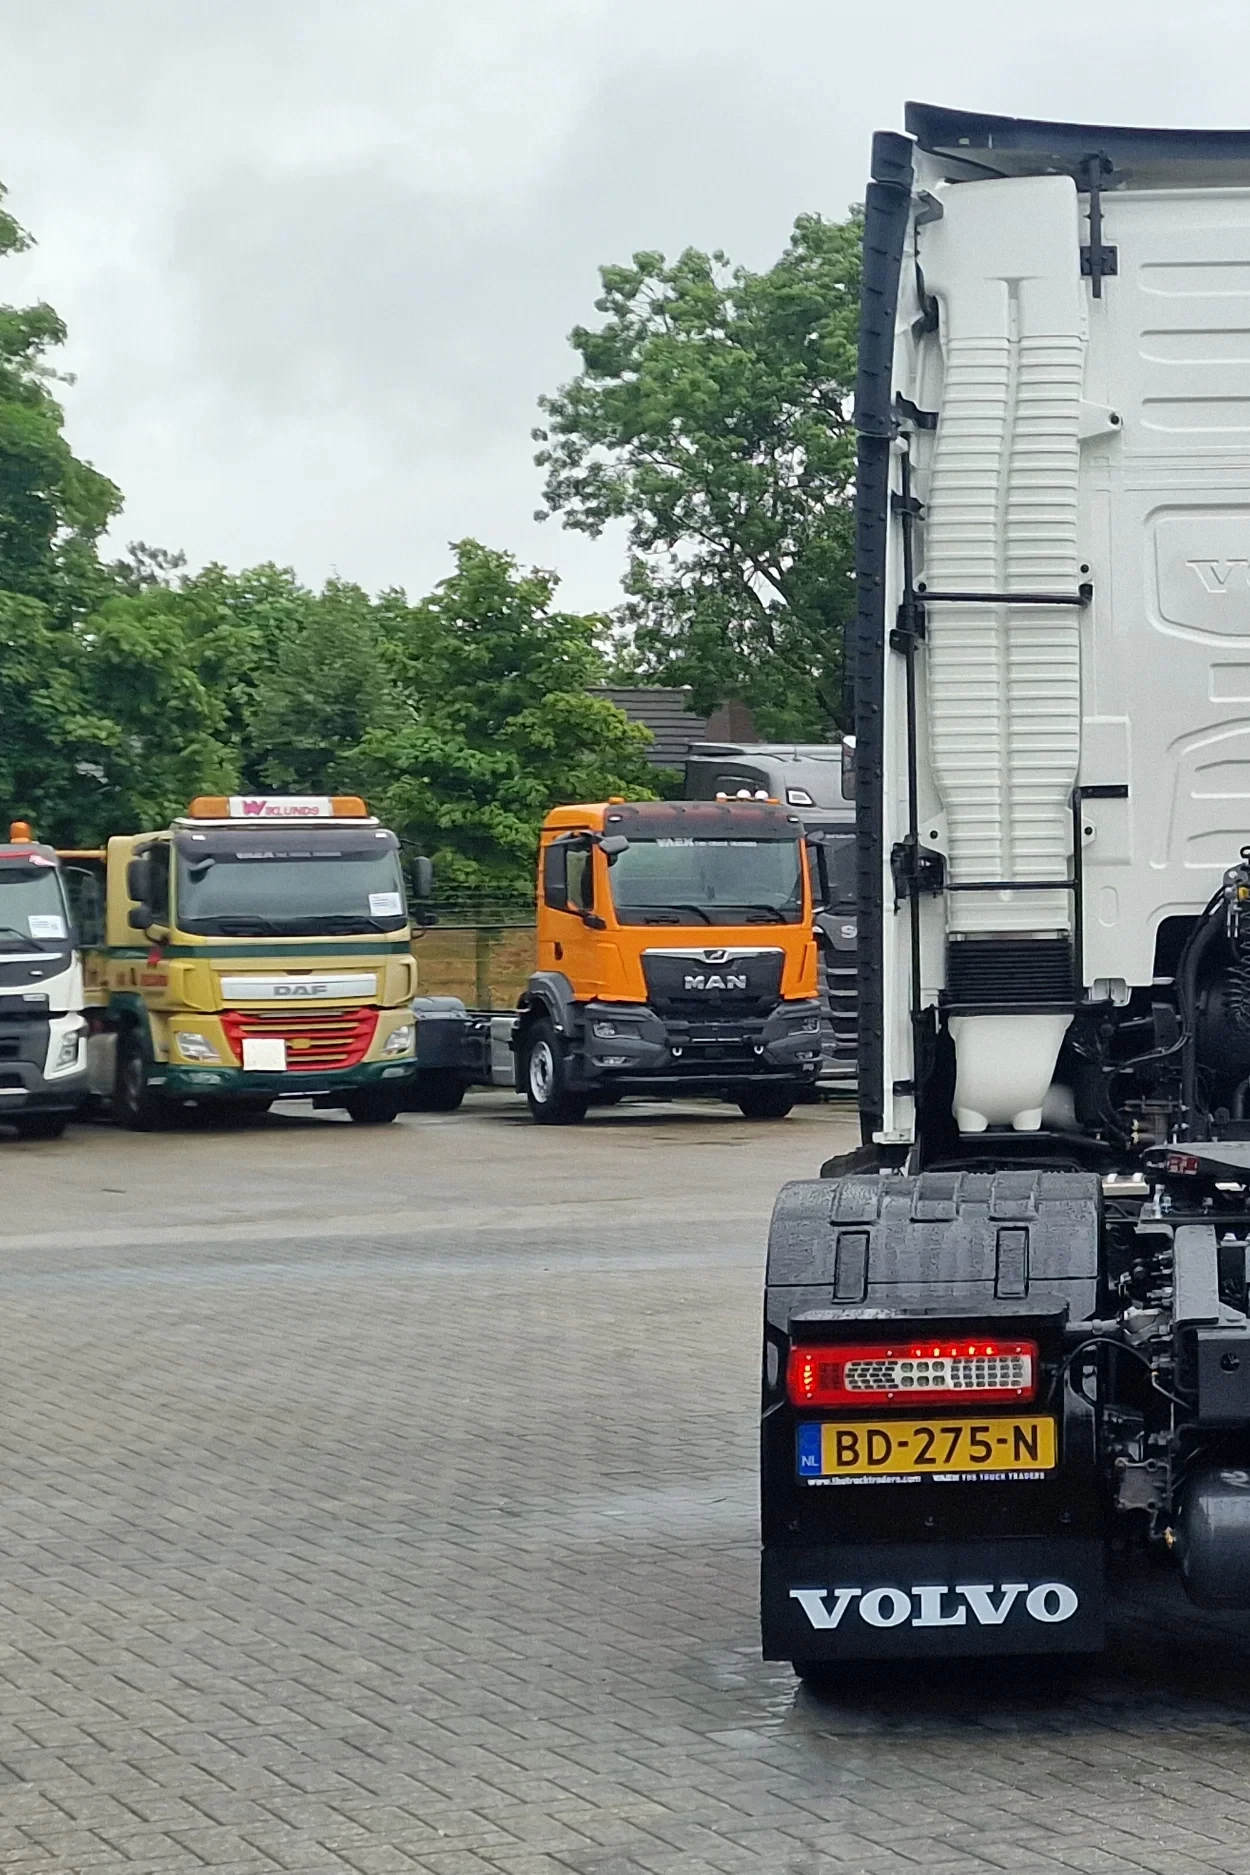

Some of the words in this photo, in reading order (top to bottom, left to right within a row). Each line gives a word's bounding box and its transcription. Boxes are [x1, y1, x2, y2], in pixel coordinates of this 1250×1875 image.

[241, 800, 320, 816] WIKLUNDS
[684, 975, 747, 990] MAN
[273, 985, 327, 996] DAF
[835, 1424, 1039, 1467] BD-275-N
[801, 1455, 819, 1467] NL
[1008, 1472, 1045, 1480] TRADERS
[789, 1583, 1079, 1630] VOLVO
